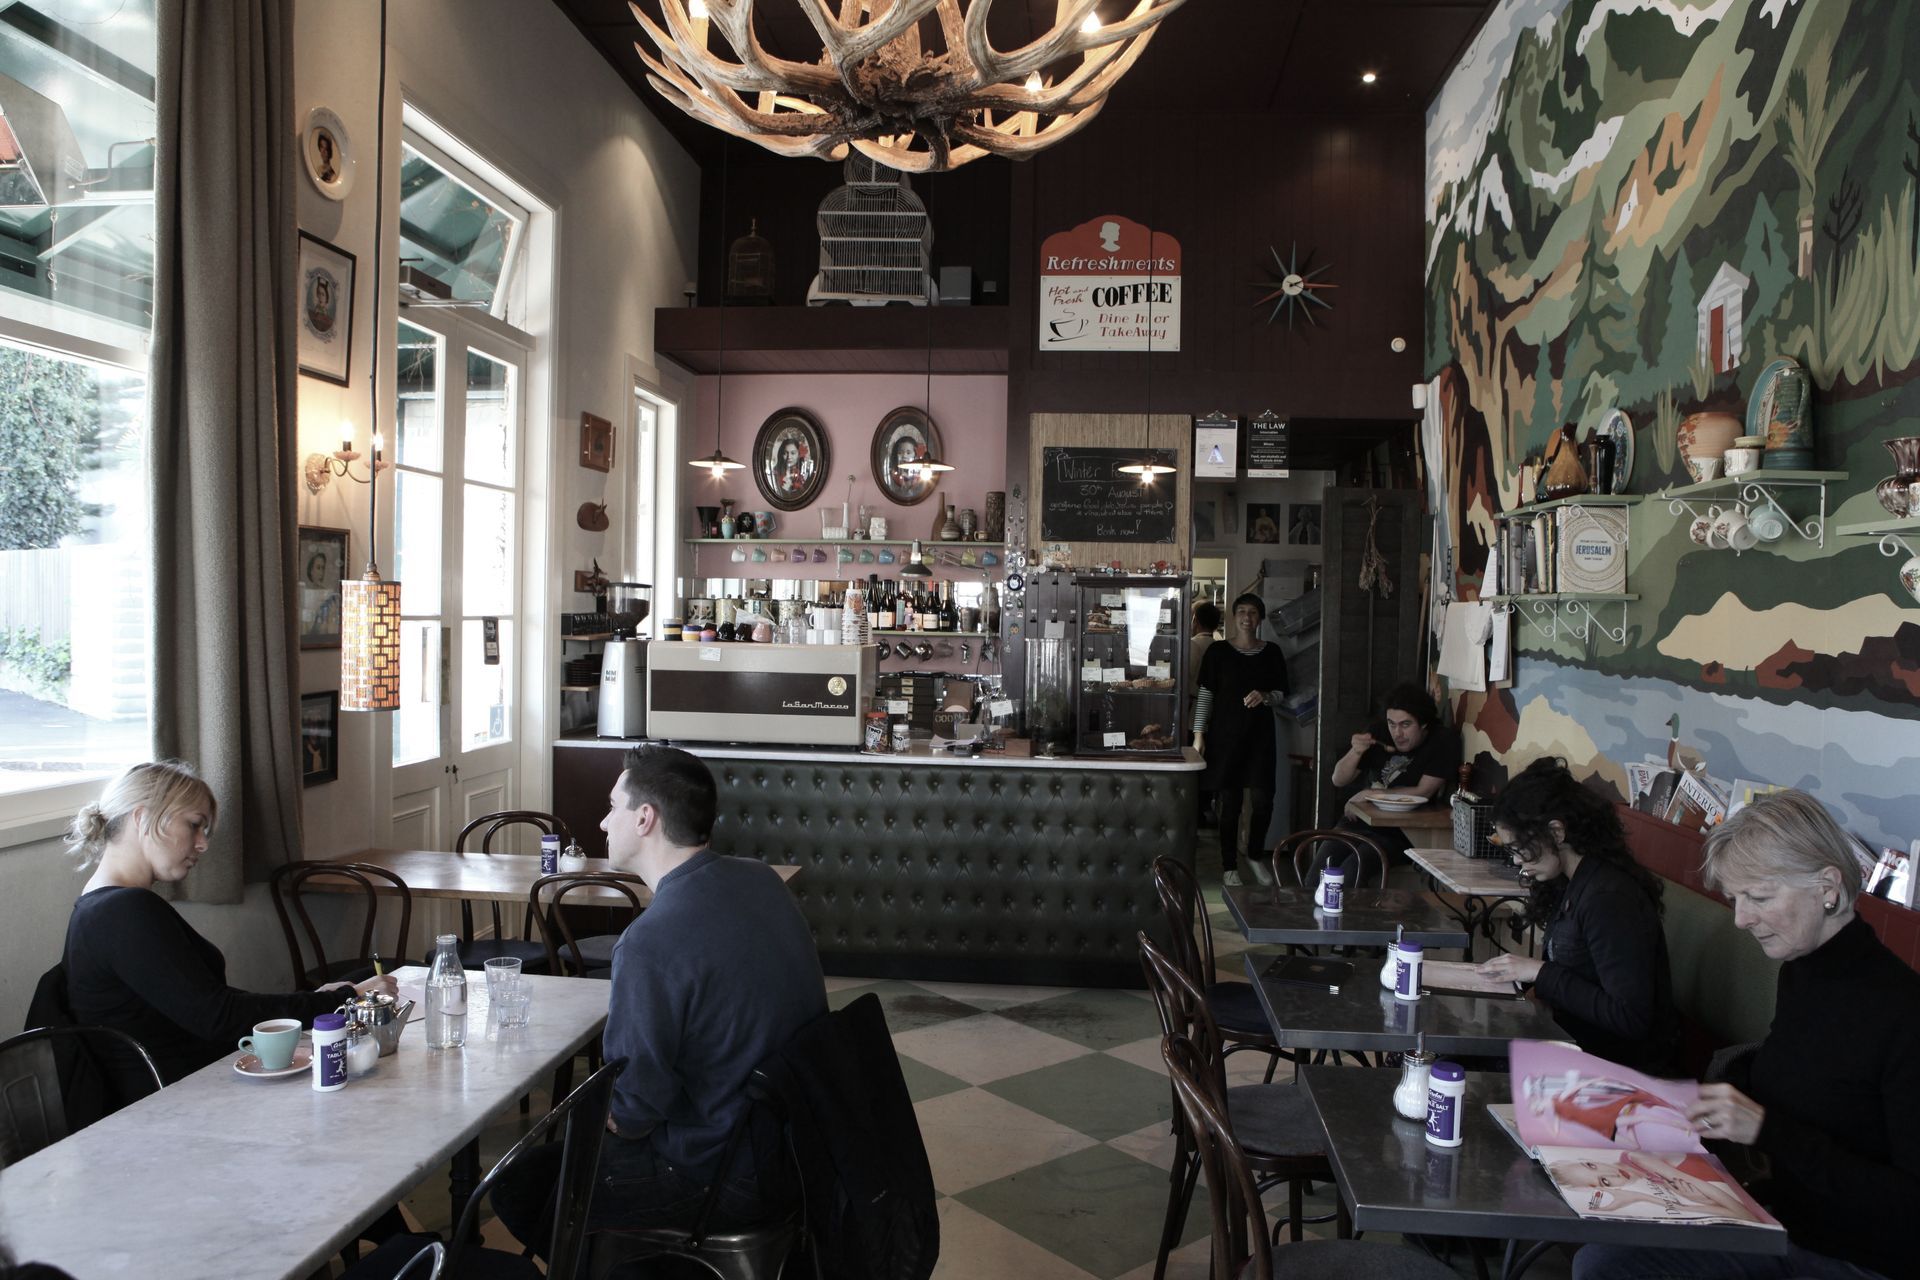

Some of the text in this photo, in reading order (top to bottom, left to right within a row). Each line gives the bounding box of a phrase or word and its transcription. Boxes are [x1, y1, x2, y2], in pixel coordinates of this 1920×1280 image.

[1046, 255, 1176, 271] Refreshments
[1048, 286, 1071, 297] Hot
[1092, 282, 1172, 307] COFFEE
[1053, 294, 1084, 306] Fresh
[1099, 313, 1170, 324] Dine In or
[1100, 326, 1166, 340] TakeAway
[1252, 422, 1286, 430] THE LAW
[1063, 459, 1101, 480] Winter
[1575, 544, 1612, 556] JERUSALEM
[1682, 779, 1719, 817] INTERIO
